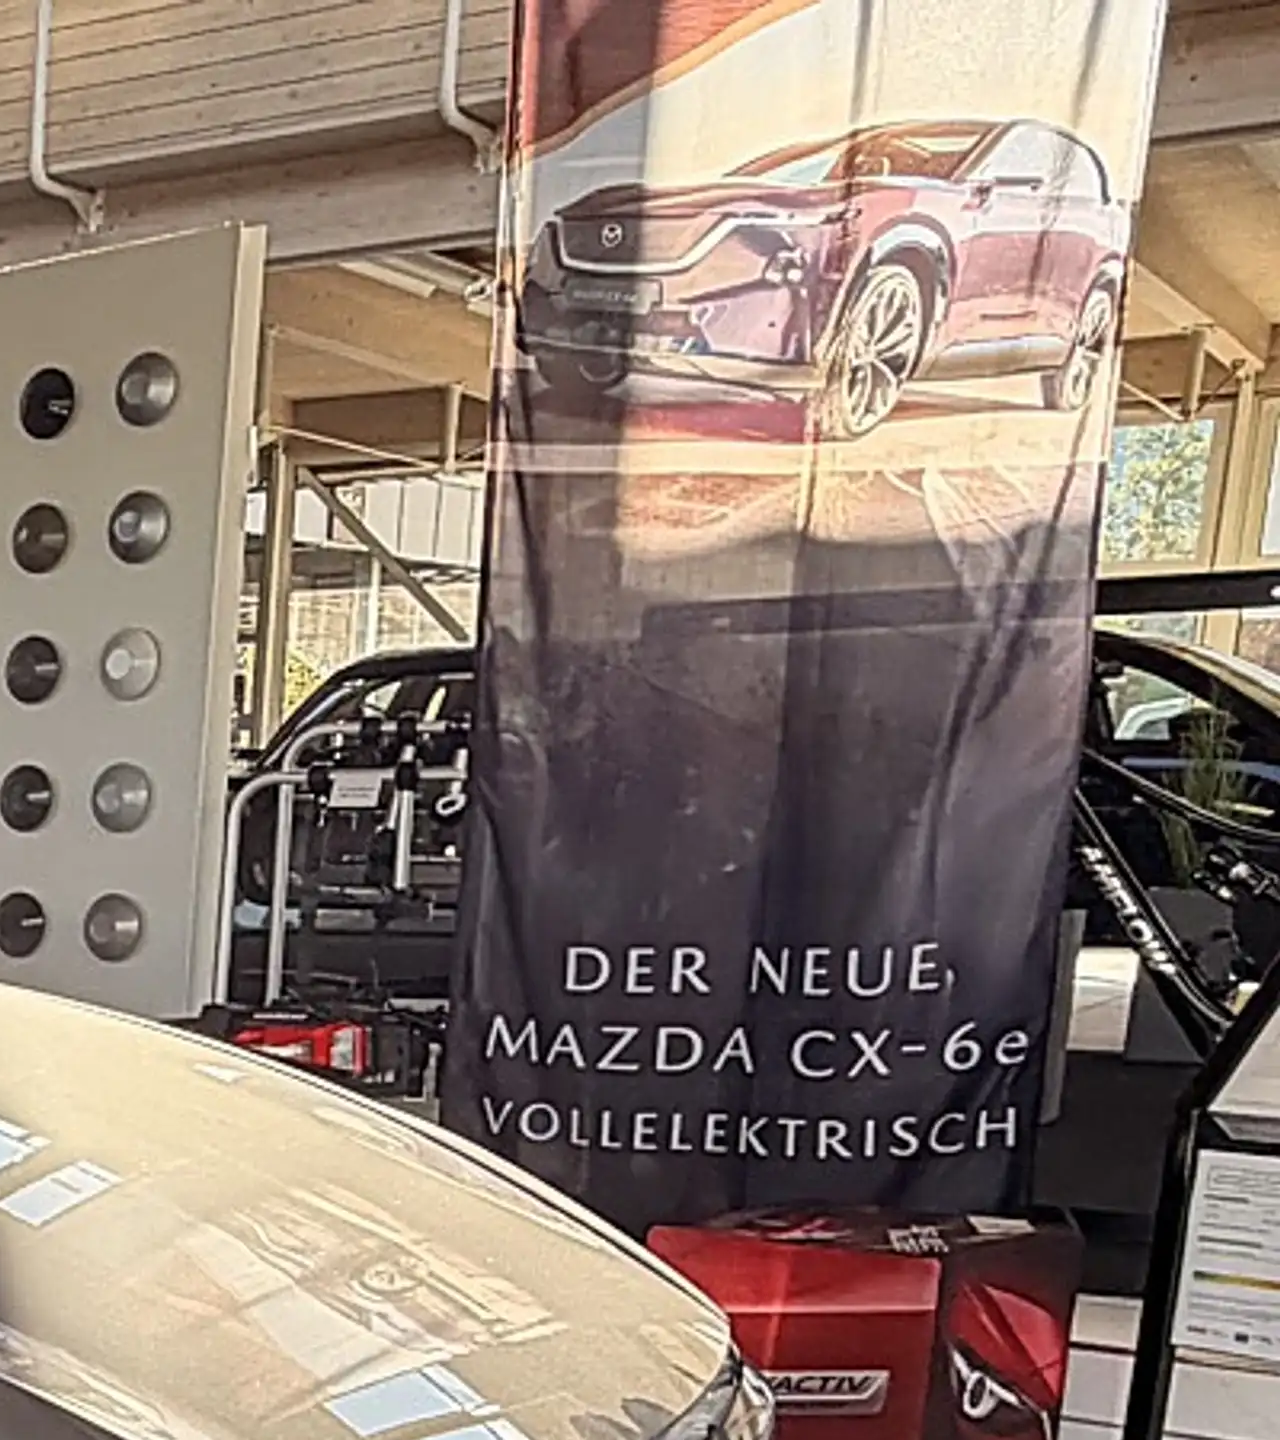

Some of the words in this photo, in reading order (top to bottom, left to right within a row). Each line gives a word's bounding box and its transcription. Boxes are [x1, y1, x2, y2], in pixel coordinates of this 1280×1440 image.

[565, 945, 711, 995] DER
[485, 1014, 756, 1074] MAZDA
[791, 1021, 1030, 1079] CX-6e
[483, 1096, 1018, 1160] VOLLELEKTRISCH
[768, 1375, 870, 1393] ACTIV
